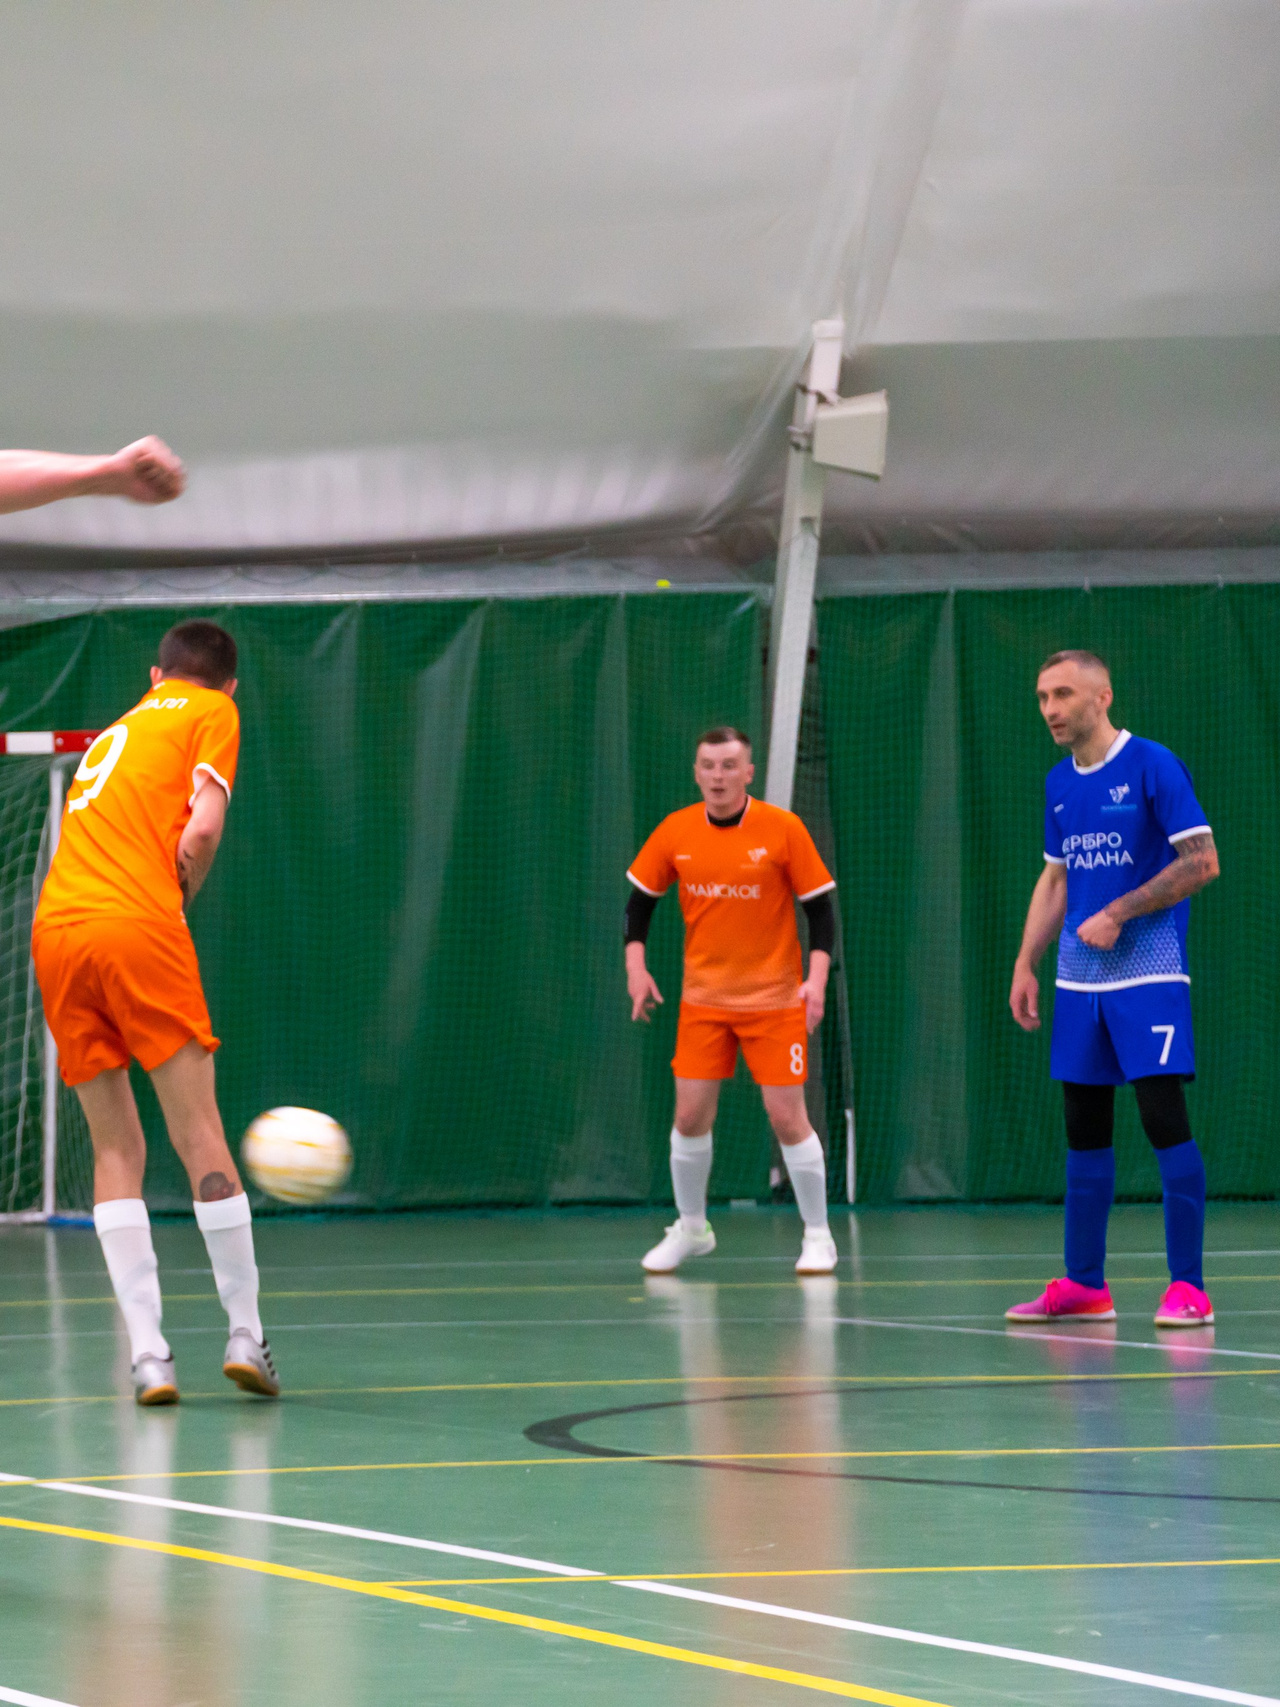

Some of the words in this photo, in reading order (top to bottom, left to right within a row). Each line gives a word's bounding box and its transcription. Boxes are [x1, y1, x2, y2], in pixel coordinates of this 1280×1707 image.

[68, 724, 128, 814] 9
[790, 1043, 804, 1075] 8
[1151, 1024, 1175, 1066] 7
